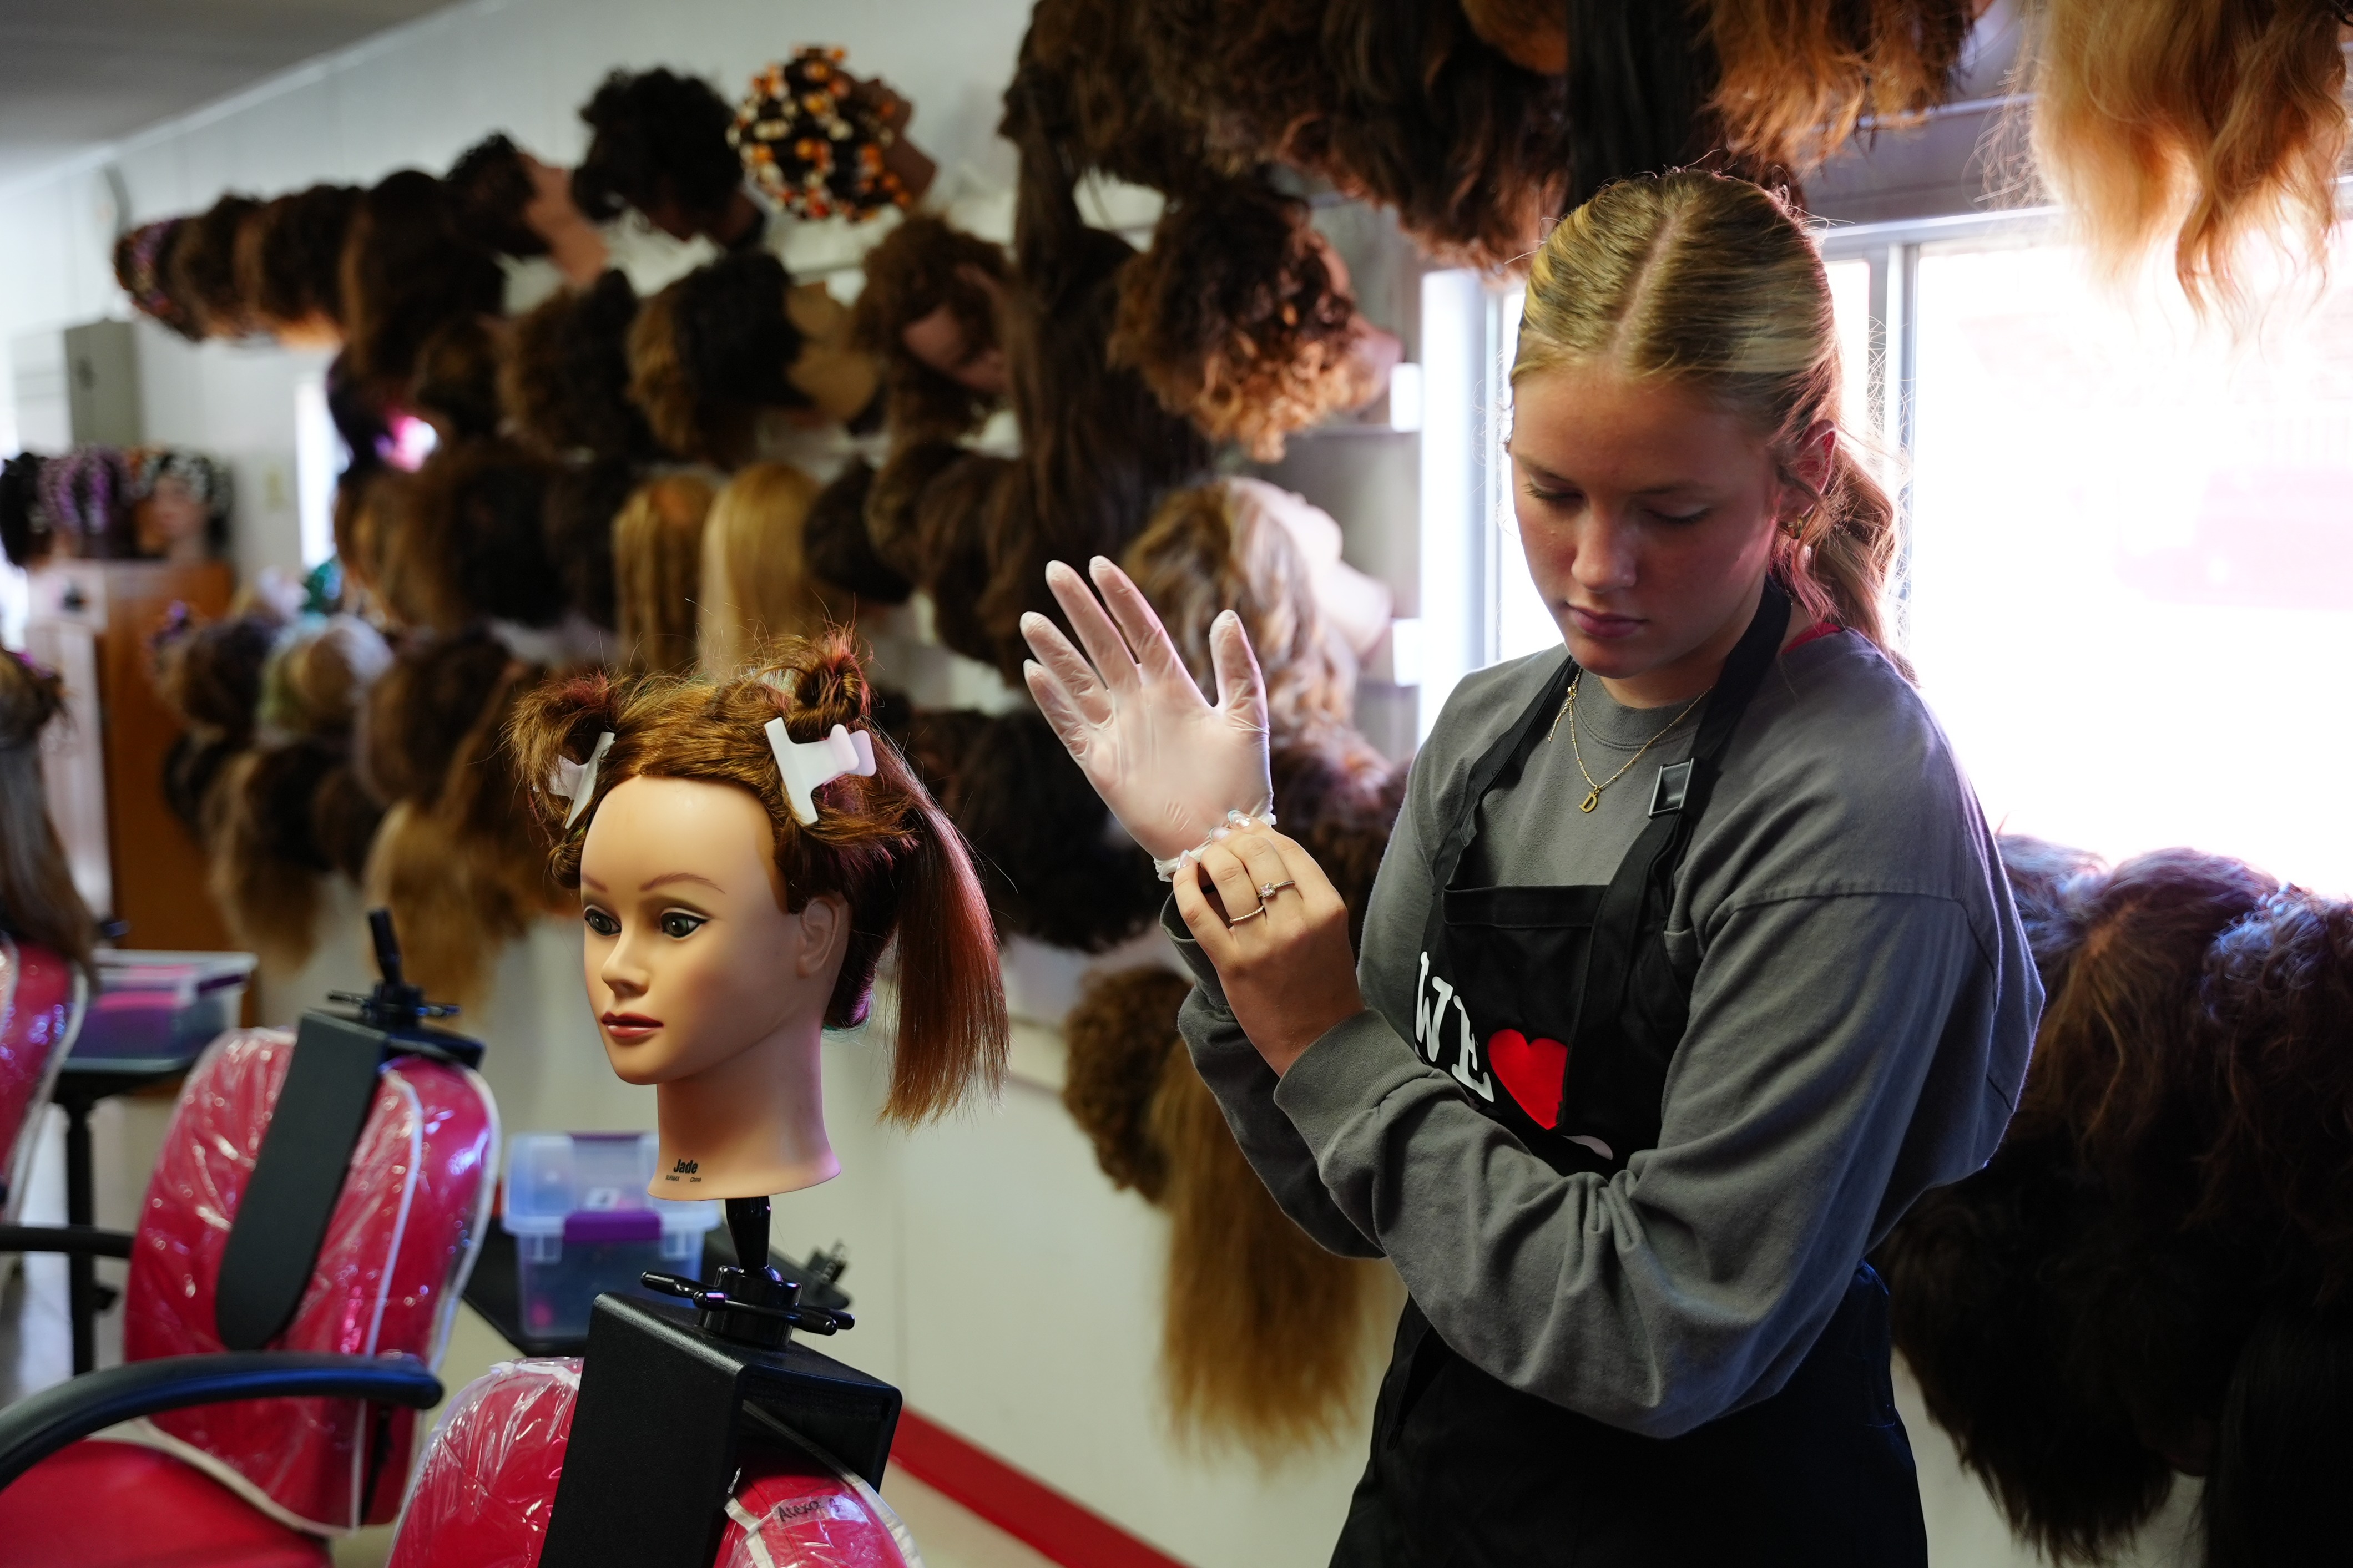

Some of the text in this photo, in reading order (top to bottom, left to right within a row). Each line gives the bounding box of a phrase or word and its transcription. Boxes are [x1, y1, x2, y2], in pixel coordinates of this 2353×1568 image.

[1579, 792, 1598, 813] D
[1416, 951, 1494, 1102] WE
[673, 1159, 698, 1174] Jade
